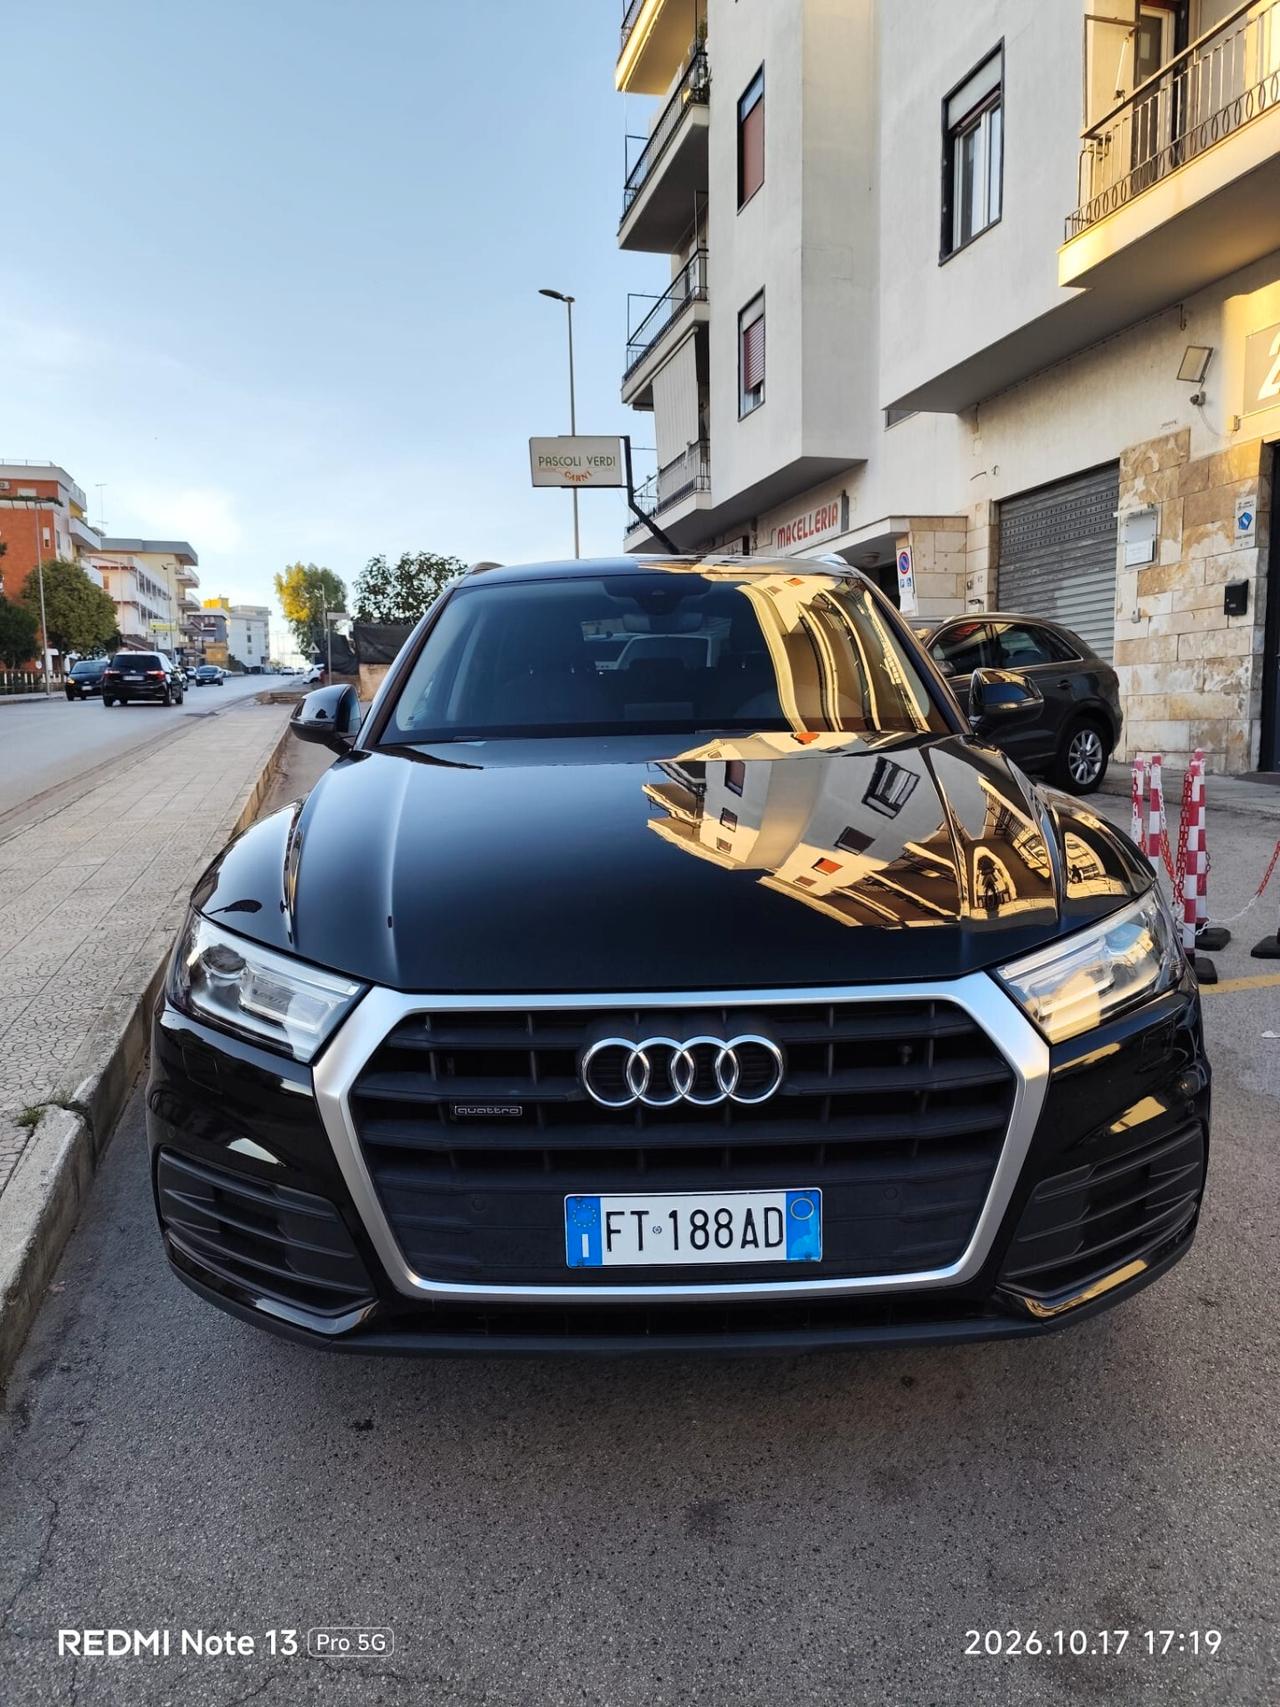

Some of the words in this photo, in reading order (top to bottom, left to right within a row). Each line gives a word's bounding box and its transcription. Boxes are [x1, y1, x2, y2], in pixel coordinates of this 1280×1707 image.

[538, 456, 581, 467] PASCOLI
[586, 456, 616, 467] VERDI
[564, 470, 593, 482] CARNI
[777, 502, 838, 549] MACELLERIA
